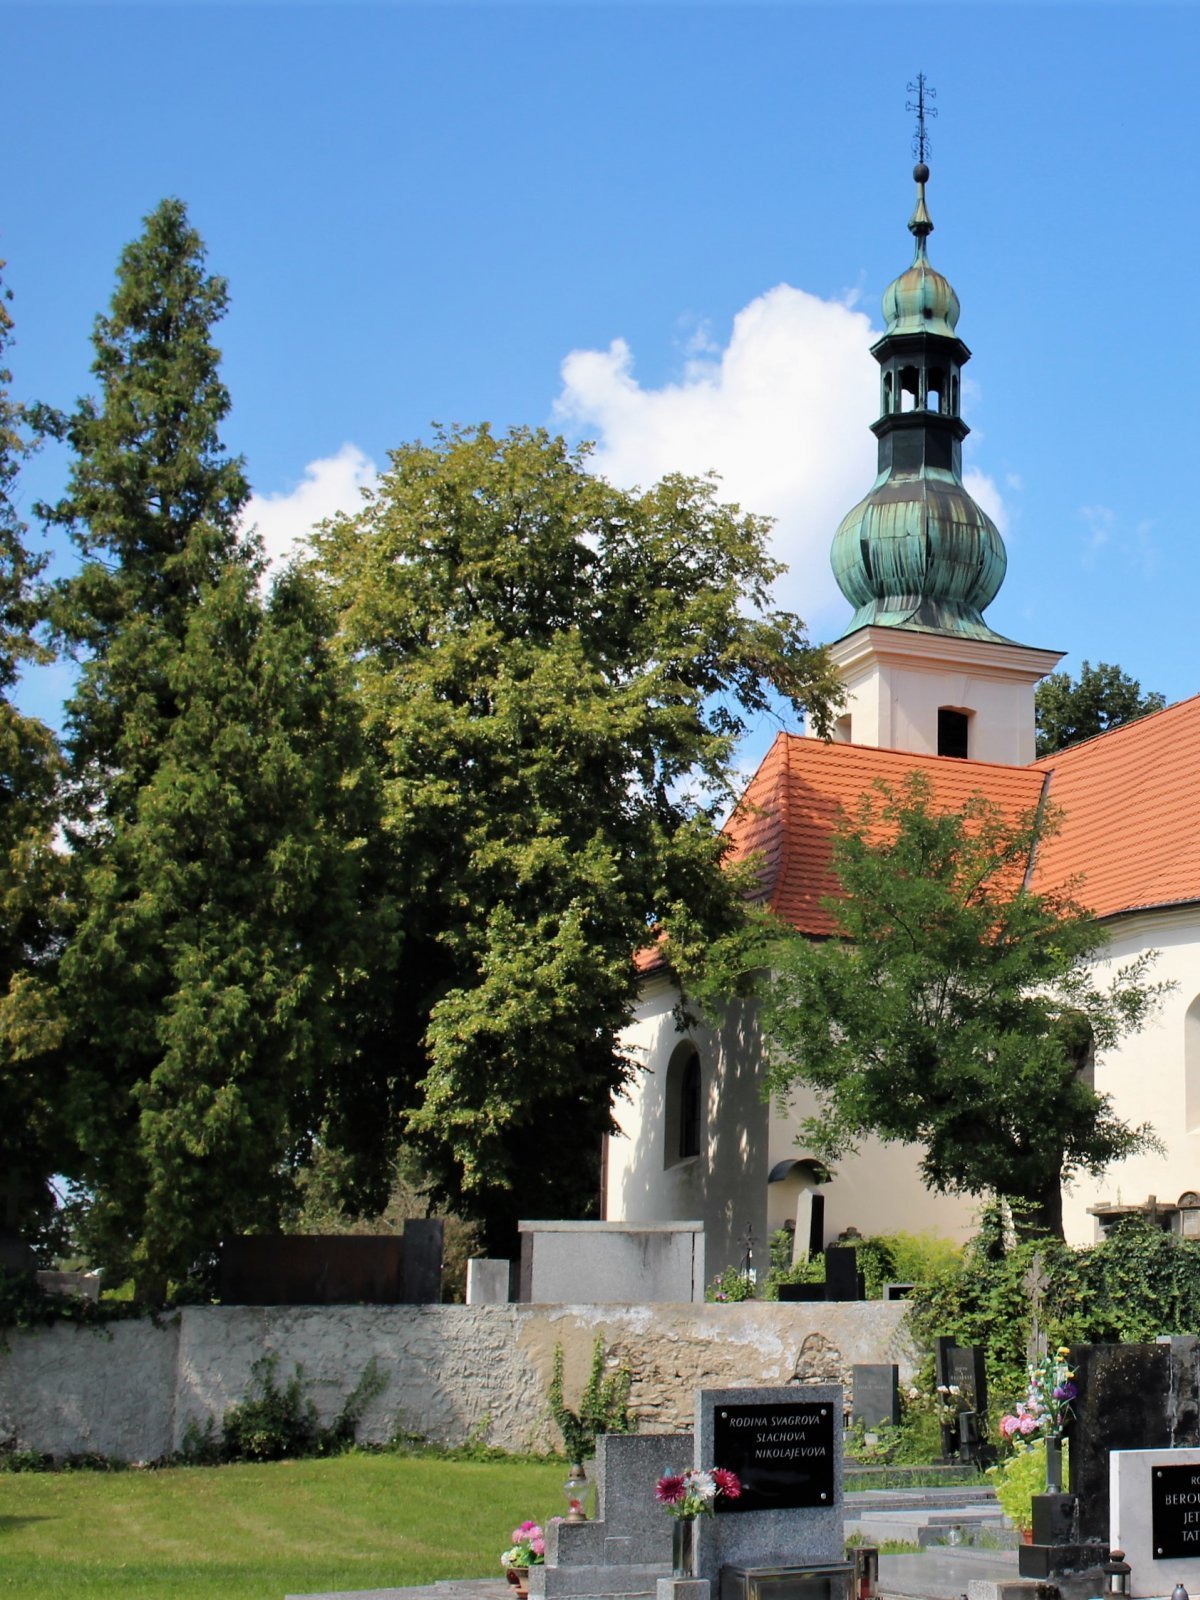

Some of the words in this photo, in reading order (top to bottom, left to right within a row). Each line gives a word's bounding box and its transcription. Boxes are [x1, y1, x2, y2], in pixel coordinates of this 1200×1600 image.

[730, 1417, 768, 1427] RODINA
[771, 1415, 820, 1426] SVAGROVA
[756, 1432, 806, 1443] SLACHOVA
[755, 1447, 826, 1460] NIKOLAJEVOVA
